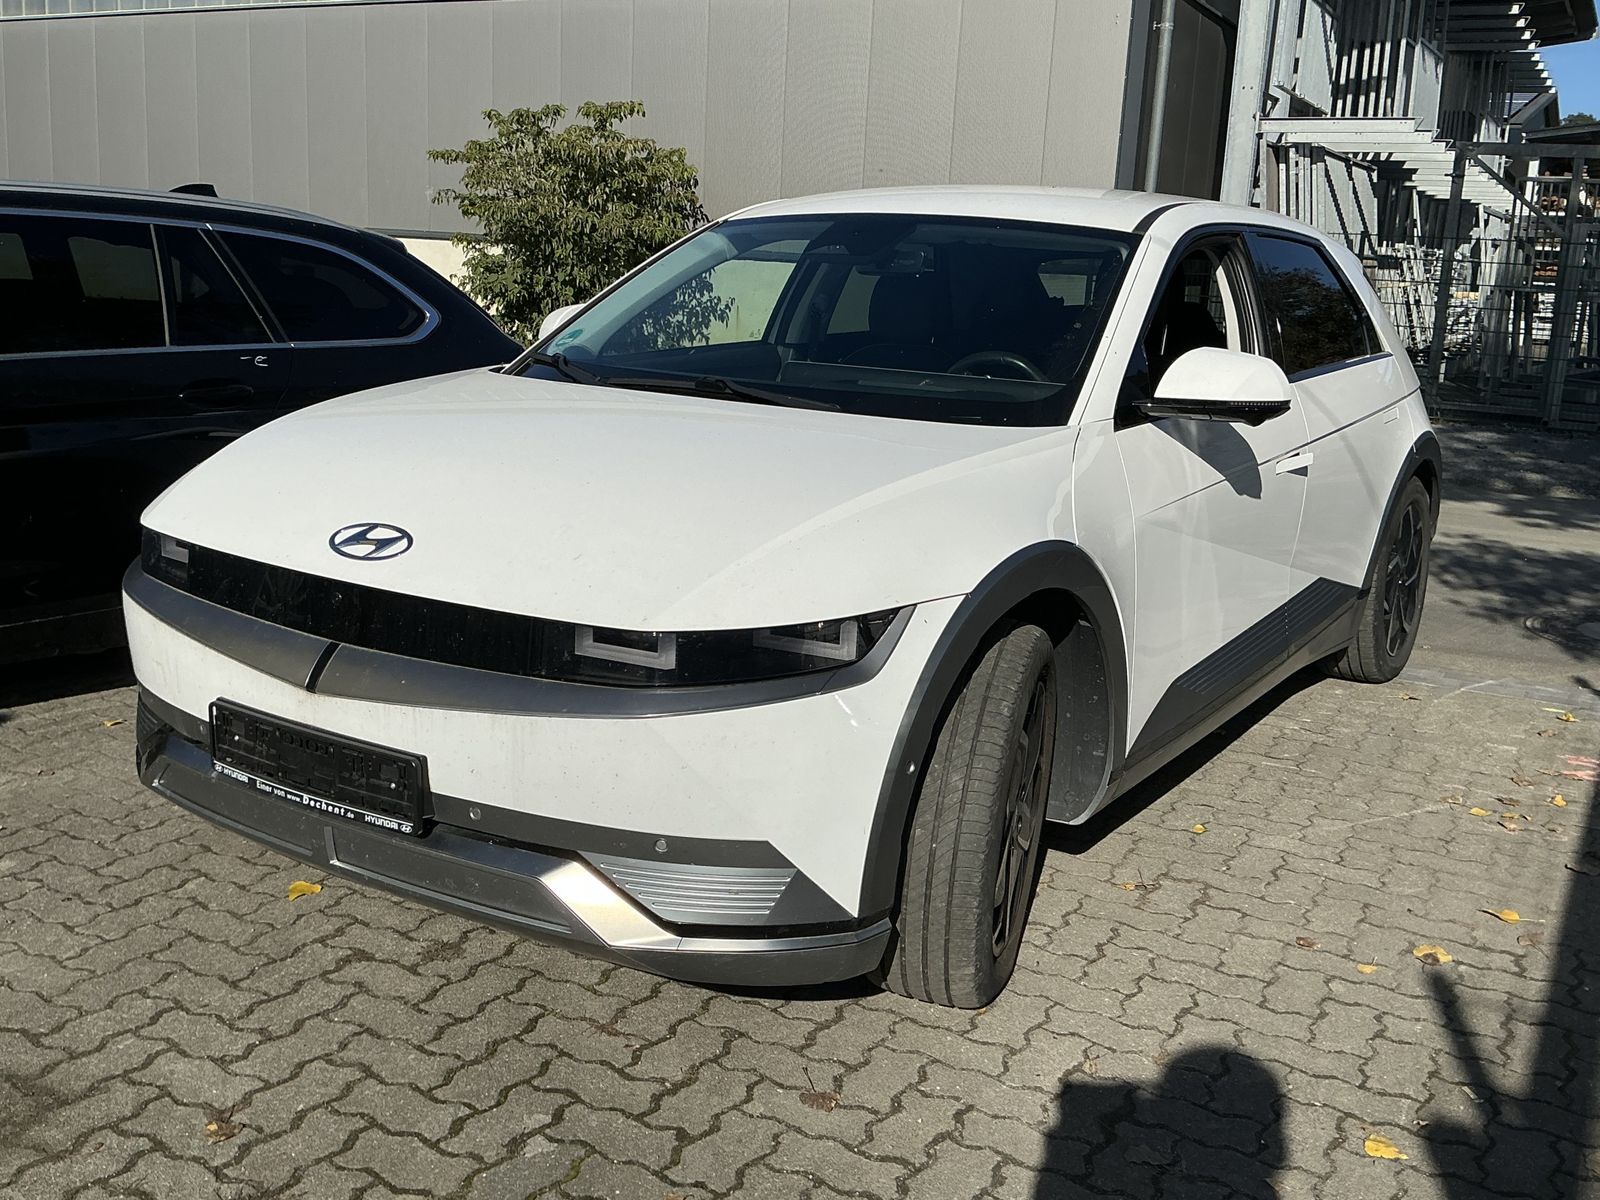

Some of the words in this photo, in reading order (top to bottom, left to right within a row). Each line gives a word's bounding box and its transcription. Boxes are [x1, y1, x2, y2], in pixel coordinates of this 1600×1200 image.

[256, 780, 272, 793] Einer
[273, 788, 286, 797] von
[364, 814, 399, 830] HYUNDAI
